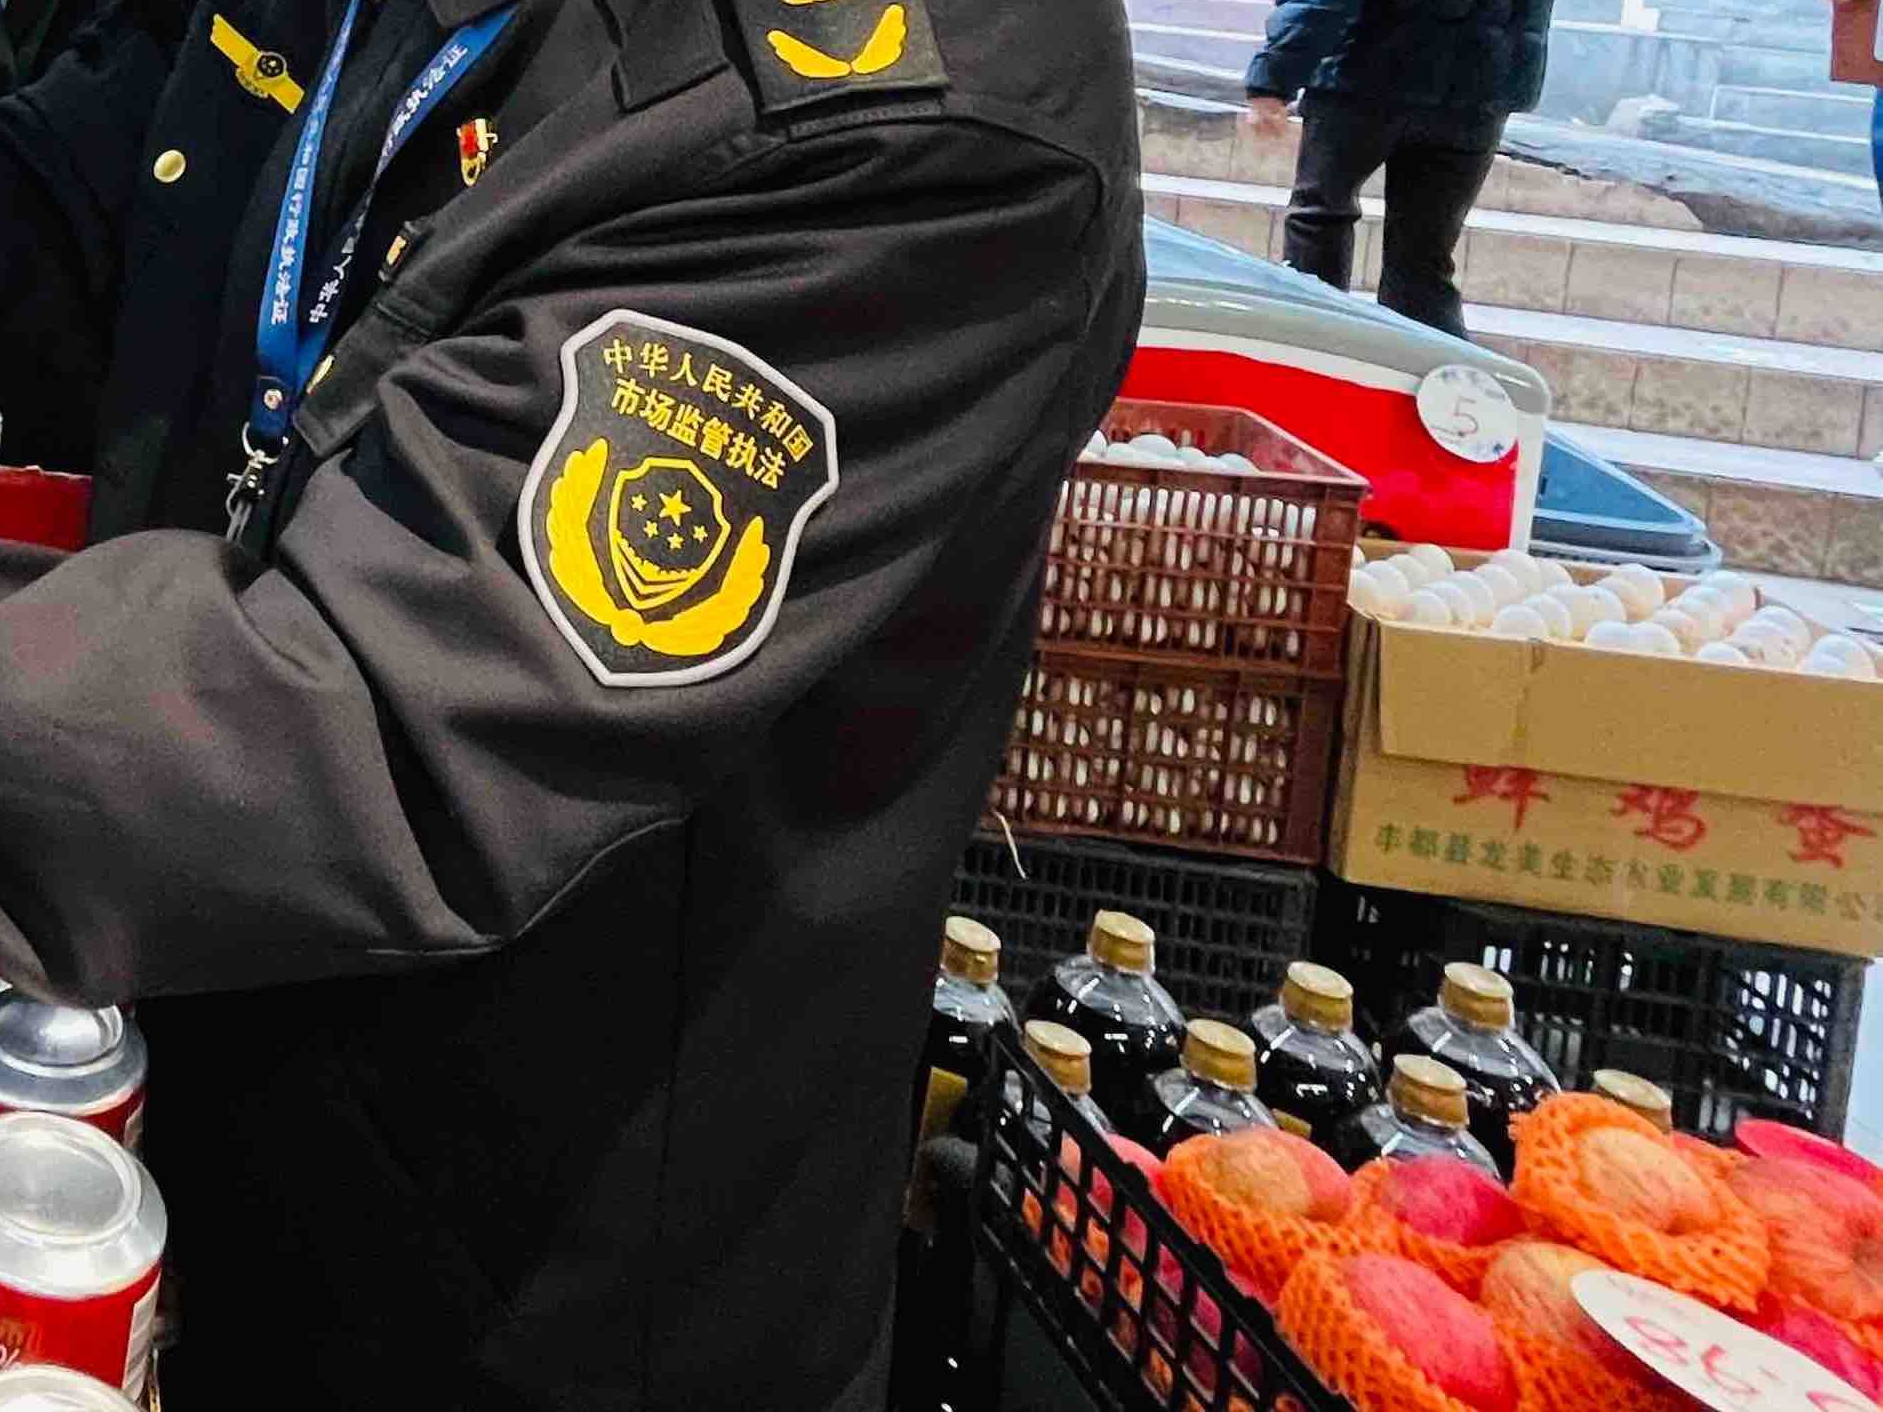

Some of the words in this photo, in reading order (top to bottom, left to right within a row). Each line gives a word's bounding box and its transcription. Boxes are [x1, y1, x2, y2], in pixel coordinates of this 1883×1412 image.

[603, 338, 814, 463] 中华人民共和国
[610, 378, 789, 489] 市场监管执法
